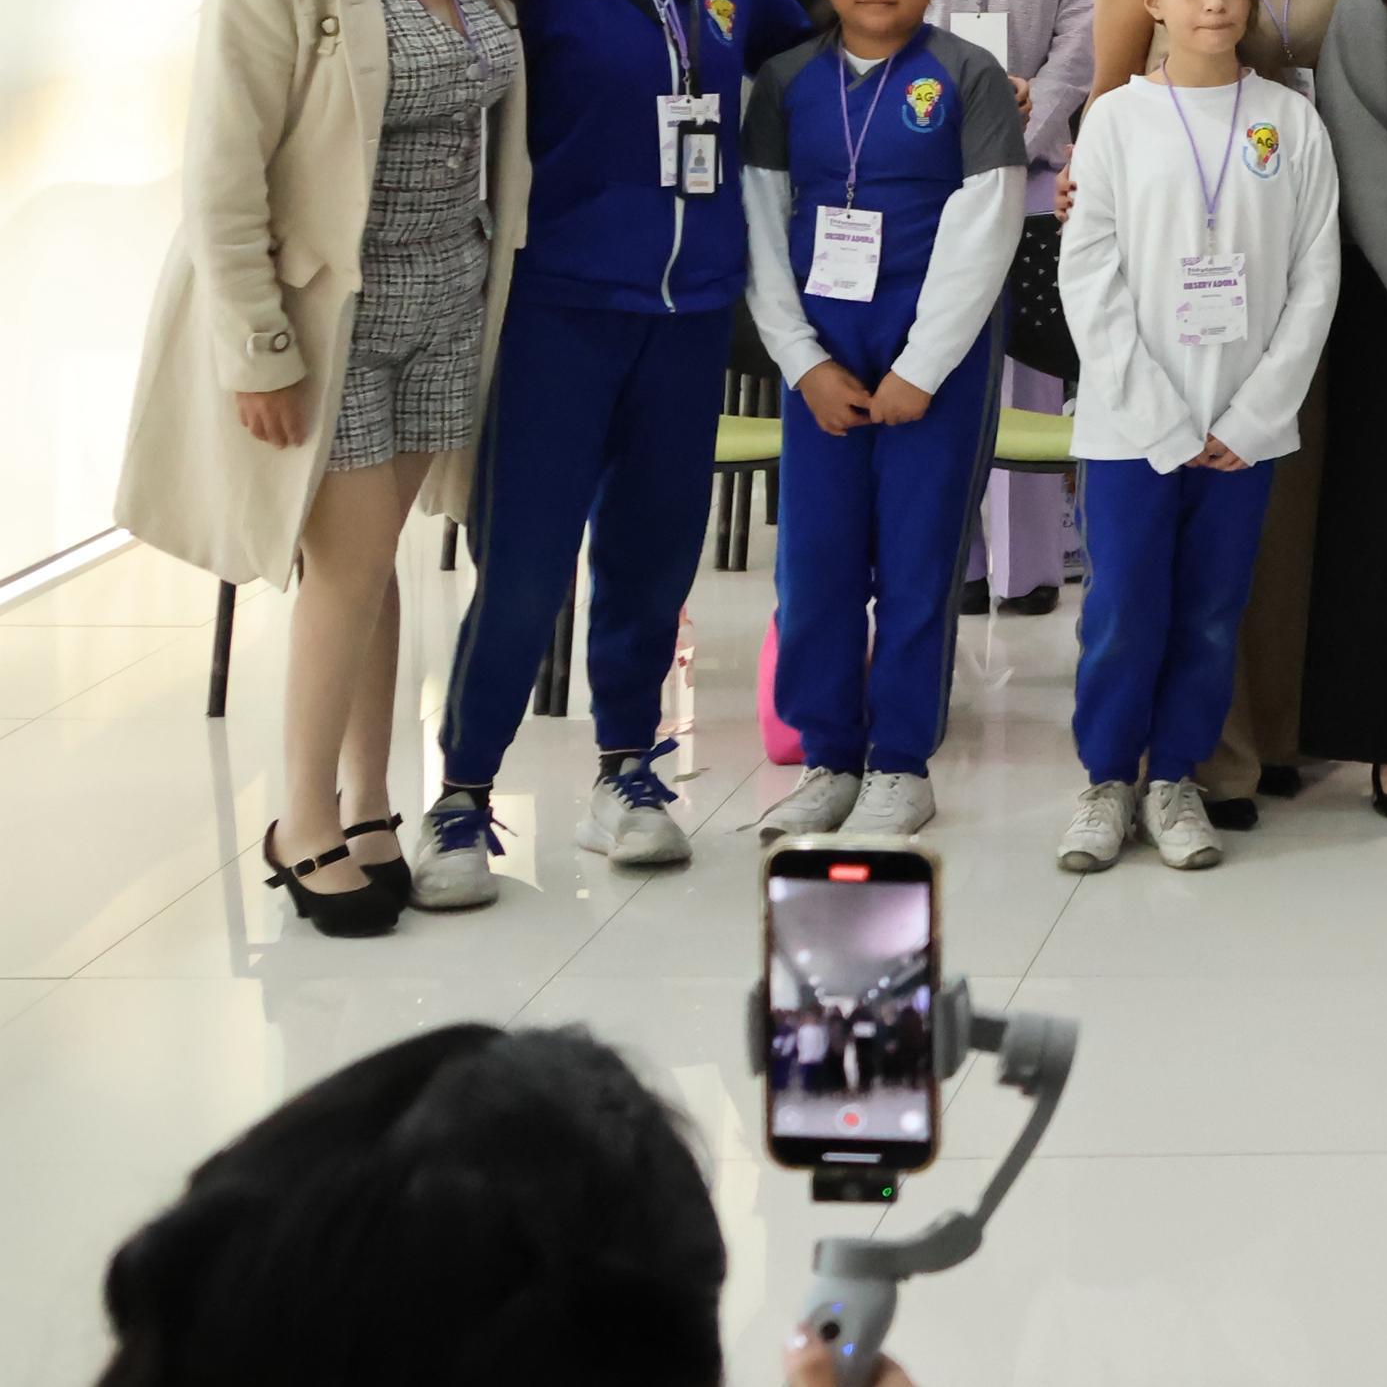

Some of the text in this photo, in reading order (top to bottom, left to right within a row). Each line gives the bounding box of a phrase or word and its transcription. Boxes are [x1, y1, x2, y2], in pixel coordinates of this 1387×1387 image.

[916, 92, 934, 102] AG
[1256, 136, 1273, 148] AG
[1183, 279, 1238, 290] OBSERVADORA
